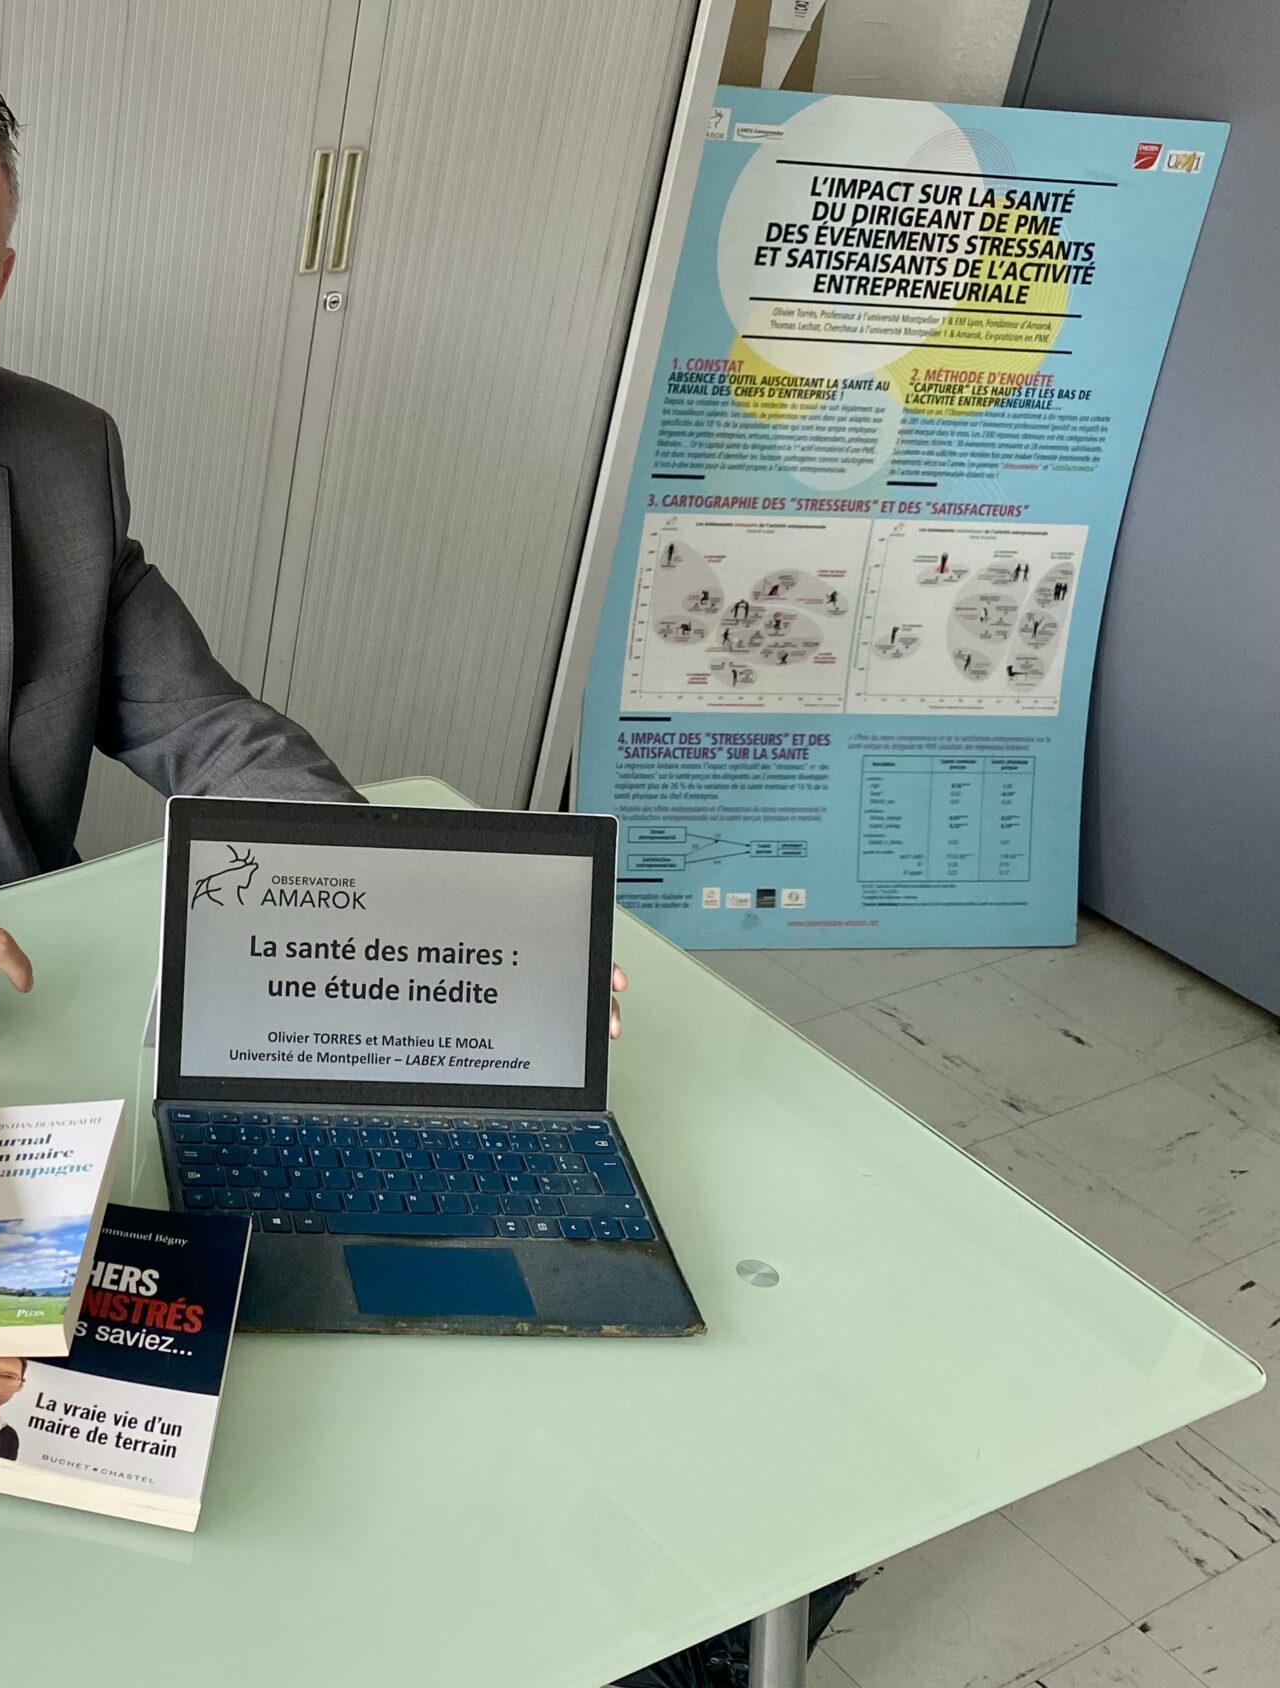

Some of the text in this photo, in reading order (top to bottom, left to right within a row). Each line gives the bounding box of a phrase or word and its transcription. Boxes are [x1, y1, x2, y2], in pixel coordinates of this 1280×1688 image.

[810, 176, 1075, 213] L'IMPACT SUR LA SANTÉ
[812, 201, 1063, 236] DU DIRIGEANT DE PME
[766, 221, 1095, 262] DES ÉVÉNEMENTS STRESSANTS
[754, 246, 1095, 285] ET SATISFAISANTS DE L'ACTIVITÉ
[813, 274, 1029, 304] ENTREPRENEURIALE
[672, 358, 745, 373] 1. CONSTAT
[910, 369, 920, 382] 2.
[924, 368, 984, 384] MÉTHODE
[667, 383, 837, 400] TRAVAIL DES CHEFS D'ENTREPRISE
[669, 371, 890, 391] ABSENCE D'OUTIL AUSCULTANT LA SANTÉ AU
[972, 385, 988, 396] LES
[990, 386, 1022, 398] HAUTS
[1025, 388, 1036, 398] ET
[1039, 388, 1055, 399] LES
[1057, 389, 1077, 400] BAS
[1079, 390, 1092, 401] DE
[647, 494, 658, 507] 3.
[662, 494, 757, 509] CARTOGRAPHIE
[762, 497, 786, 511] DES
[881, 500, 896, 513] ET
[898, 501, 921, 514] DES
[617, 732, 628, 745] 4.
[631, 732, 676, 745] IMPACT
[679, 732, 701, 745] DES
[792, 733, 806, 746] ET
[808, 734, 831, 746] DES
[727, 747, 750, 760] SUR
[753, 747, 768, 760] LA
[272, 875, 356, 888] OBSERVATOIRE
[261, 888, 367, 910] AMAROK
[250, 935, 503, 966] La santé des maires
[268, 975, 498, 1004] une étude inédite
[267, 1030, 494, 1050] Olivier TORRES et Mathieu LE MOAL
[229, 1048, 531, 1071] Université de Montpellier LABEX Entreprendre
[15, 1149, 74, 1161] maire
[102, 1227, 188, 1247] mmanuel Bégny
[90, 1260, 160, 1297] HERS
[81, 1287, 204, 1334] NISTRÉS
[35, 1392, 182, 1438] La vraie vie d'un
[28, 1415, 177, 1458] maire de terrain
